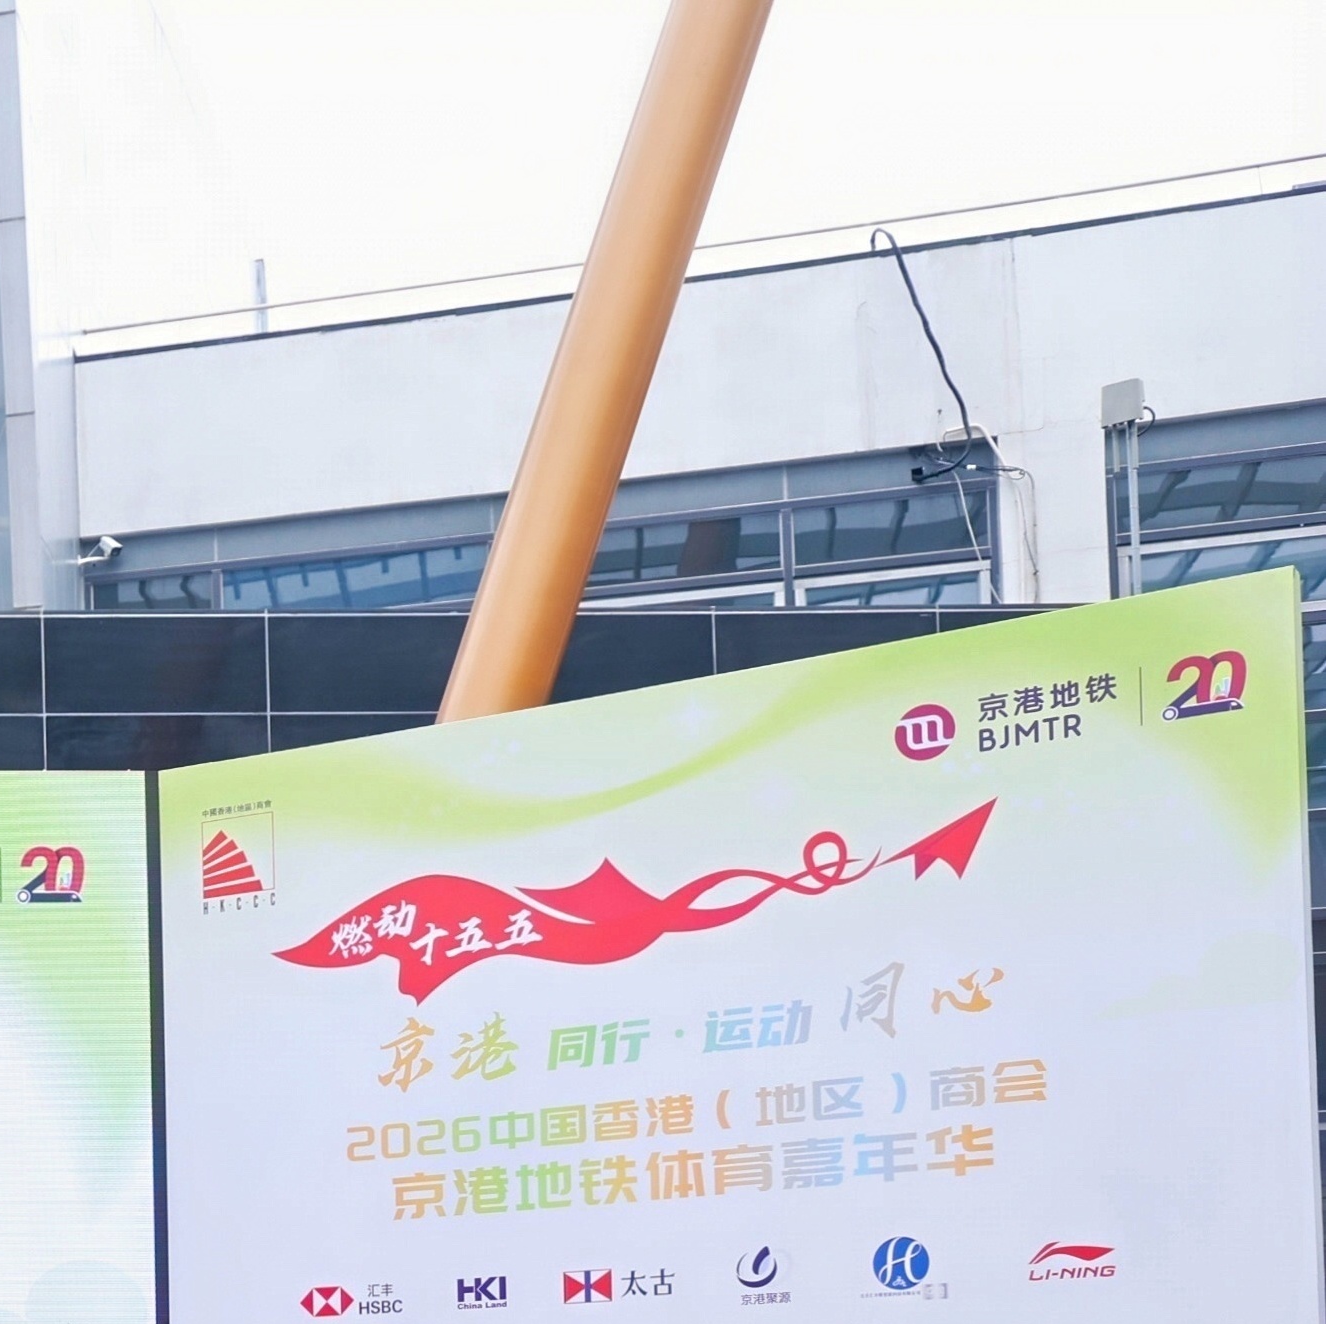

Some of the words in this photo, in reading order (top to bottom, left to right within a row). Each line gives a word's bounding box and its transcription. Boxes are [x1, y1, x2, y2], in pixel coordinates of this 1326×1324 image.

[977, 673, 1117, 722] 京港地铁
[978, 714, 1082, 753] BJMTR
[392, 1124, 995, 1222] 京港地铁体育嘉年华
[621, 1268, 675, 1298] 太古
[1028, 1265, 1116, 1282] LI-NING
[367, 1283, 394, 1298] 汇丰
[457, 1276, 507, 1303] HKI
[740, 1290, 792, 1307] 京港聚源
[358, 1299, 403, 1315] HSBC
[457, 1302, 483, 1310] China
[485, 1301, 508, 1309] Land
